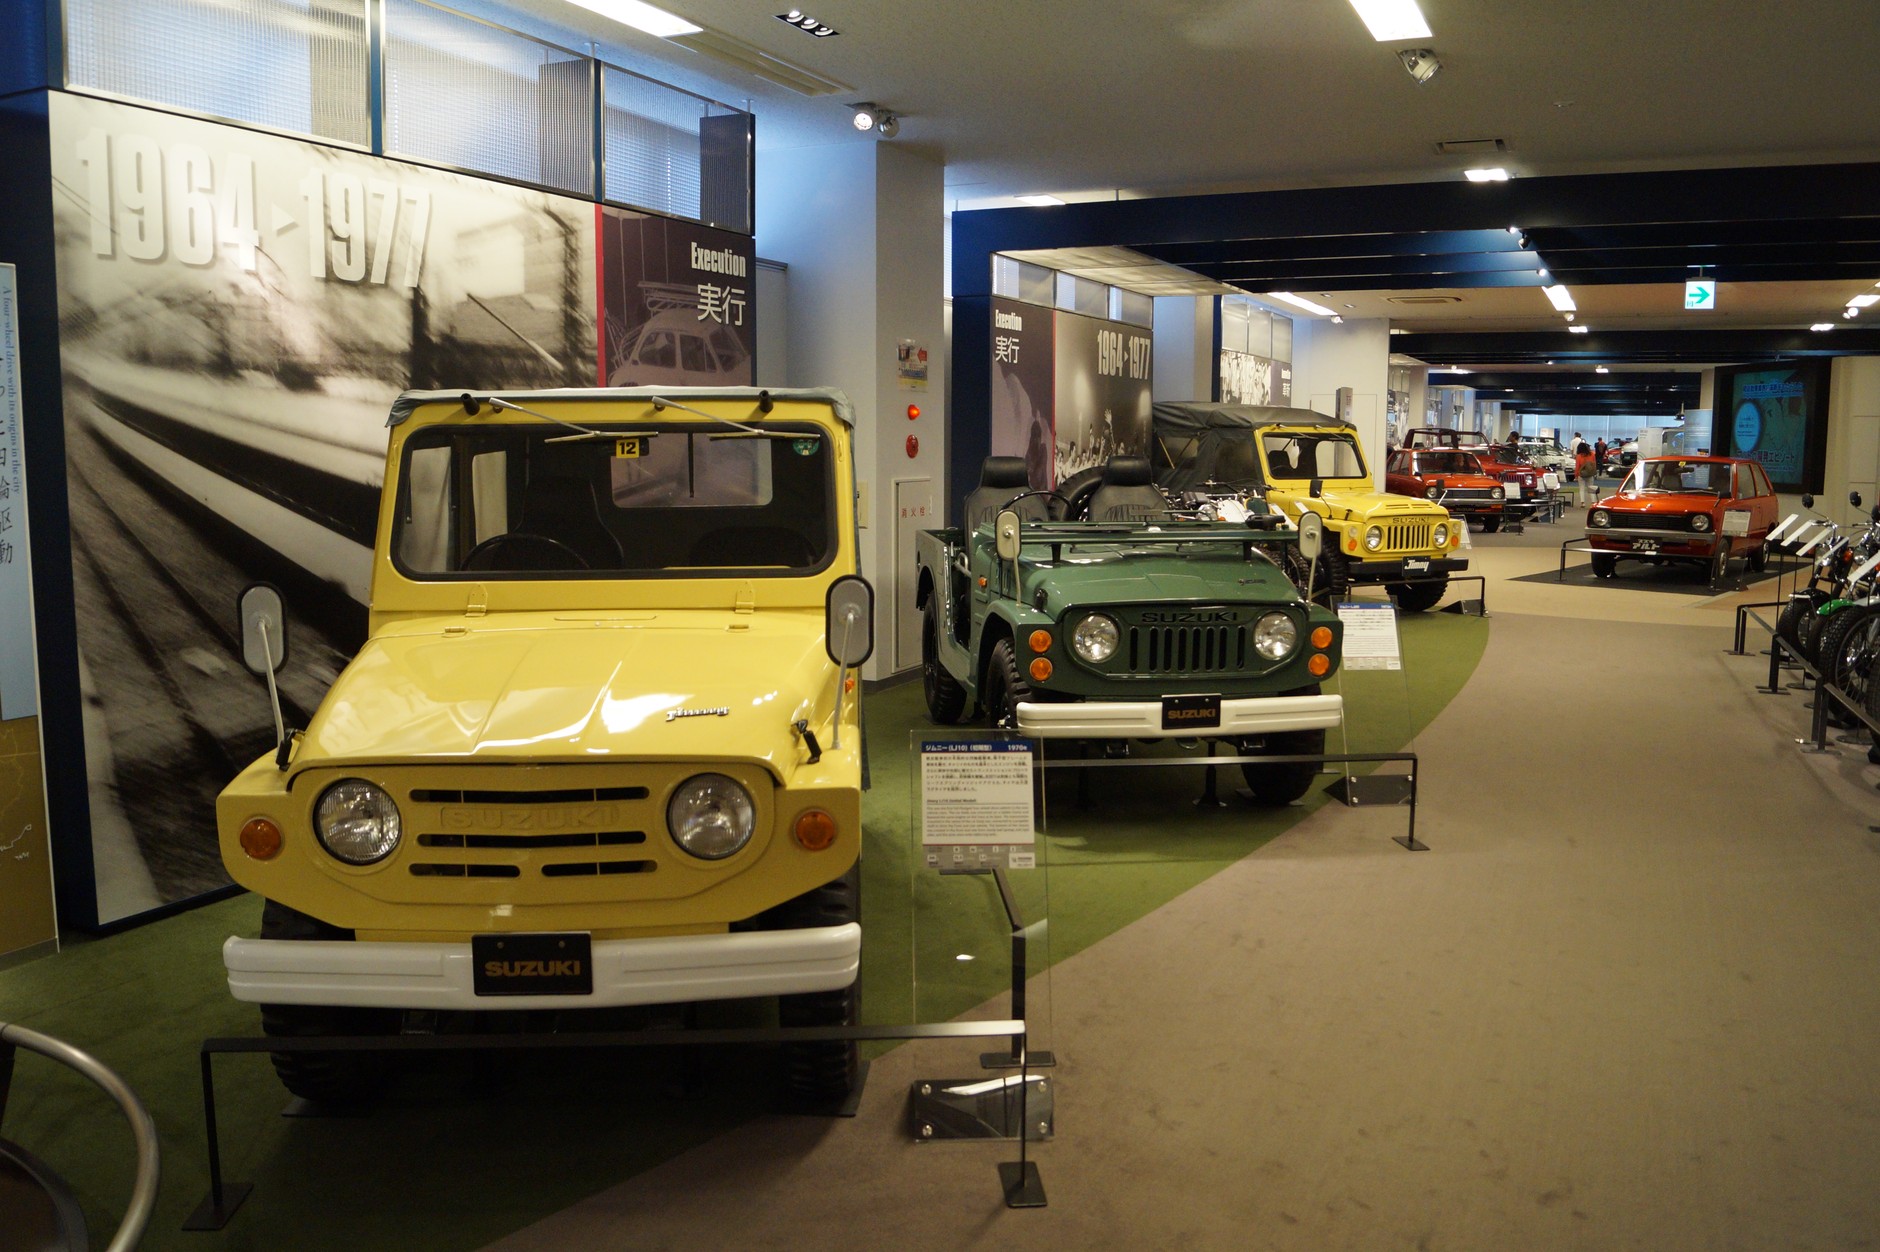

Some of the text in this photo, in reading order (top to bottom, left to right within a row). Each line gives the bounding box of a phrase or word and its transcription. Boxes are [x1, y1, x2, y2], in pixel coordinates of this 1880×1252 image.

[76, 128, 431, 288] 1964 1977
[690, 241, 747, 278] Execution
[697, 282, 747, 326] 実行
[995, 309, 1023, 332] Execution
[995, 335, 1020, 364] 実行
[1097, 329, 1151, 380] 1964 1977
[6, 351, 16, 375] drive
[7, 377, 17, 396] with
[8, 400, 17, 411] its
[8, 413, 19, 446] origins
[11, 448, 19, 457] in
[618, 442, 636, 455] 12
[11, 460, 22, 474] the
[11, 476, 21, 494] city
[901, 506, 925, 518] 消火栓
[1392, 516, 1430, 524] SUZUKI
[1404, 559, 1430, 572] Jimny
[1141, 611, 1238, 623] SUZUKI
[1167, 708, 1216, 719] SUZUKI
[446, 804, 618, 828] SUZUKI
[484, 960, 581, 977] SUZUKI
